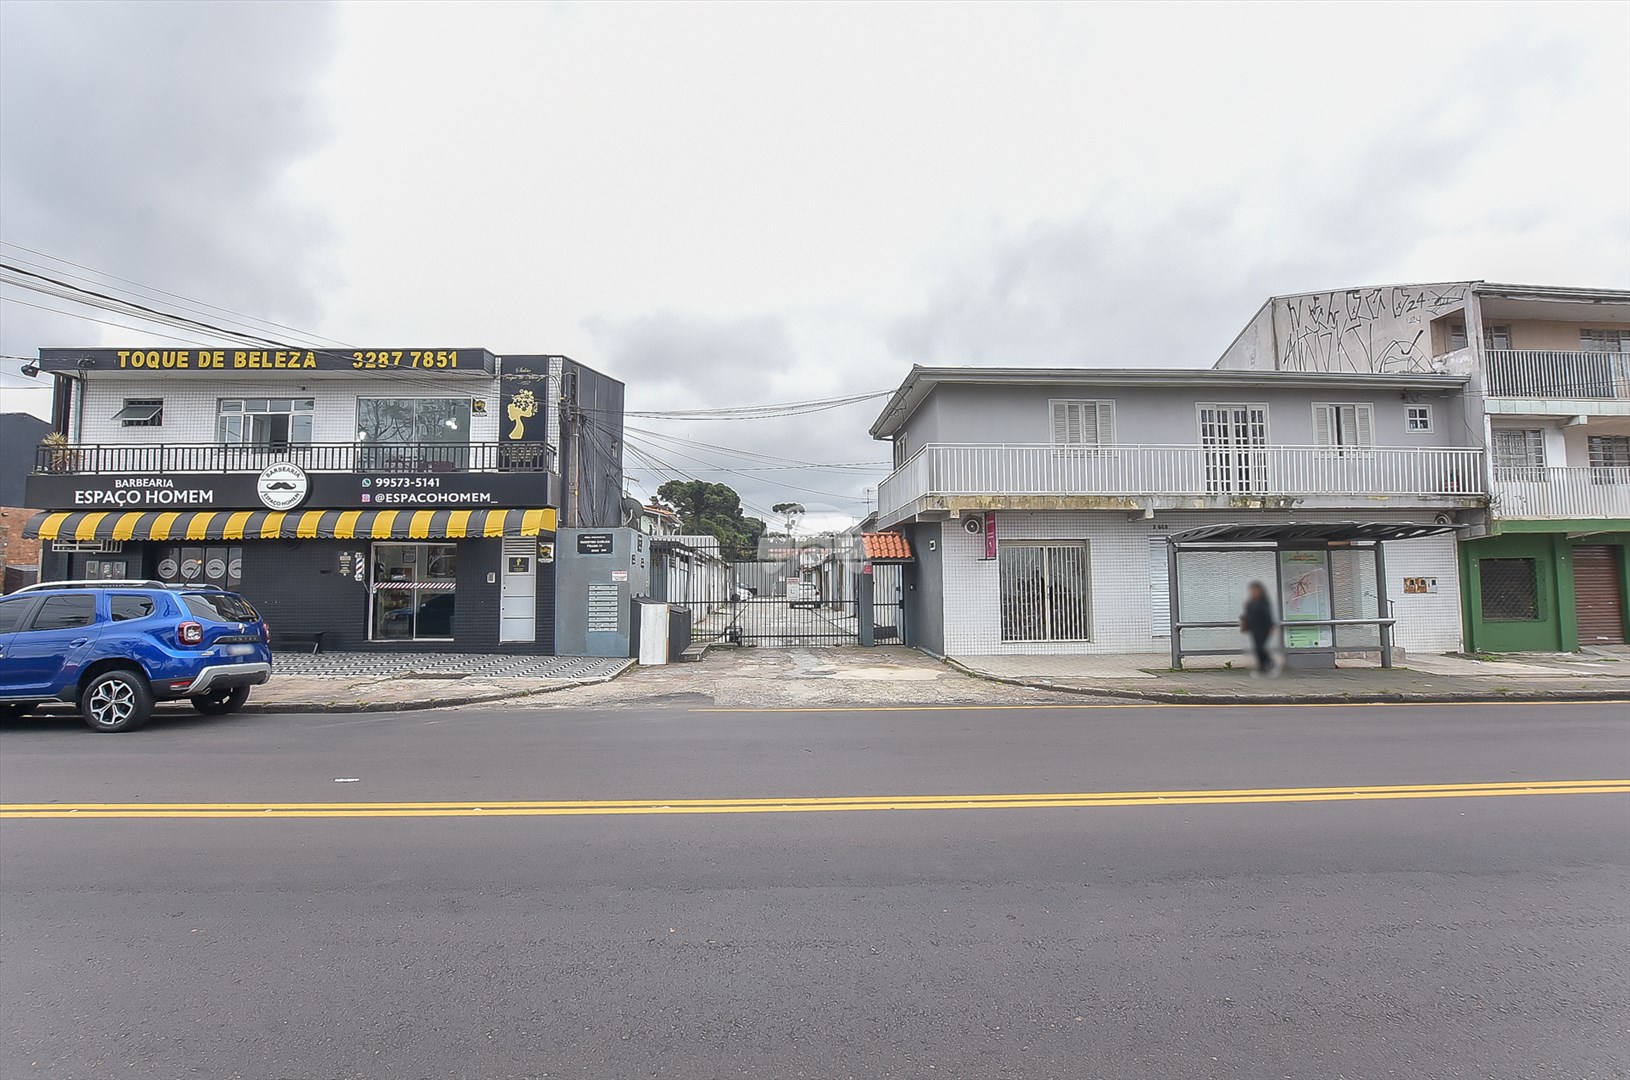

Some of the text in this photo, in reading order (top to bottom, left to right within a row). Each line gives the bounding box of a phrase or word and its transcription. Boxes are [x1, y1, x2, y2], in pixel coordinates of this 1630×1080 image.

[117, 351, 457, 369] TOQUE DE BELEZA 3287 7851
[265, 466, 301, 479] BARBEARIA
[114, 478, 174, 488] BARBEARIA
[375, 477, 440, 488] 99573-5141
[74, 489, 214, 507] ESPAÇO HOMEM
[374, 492, 499, 504] @ESPACOHOMEM_
